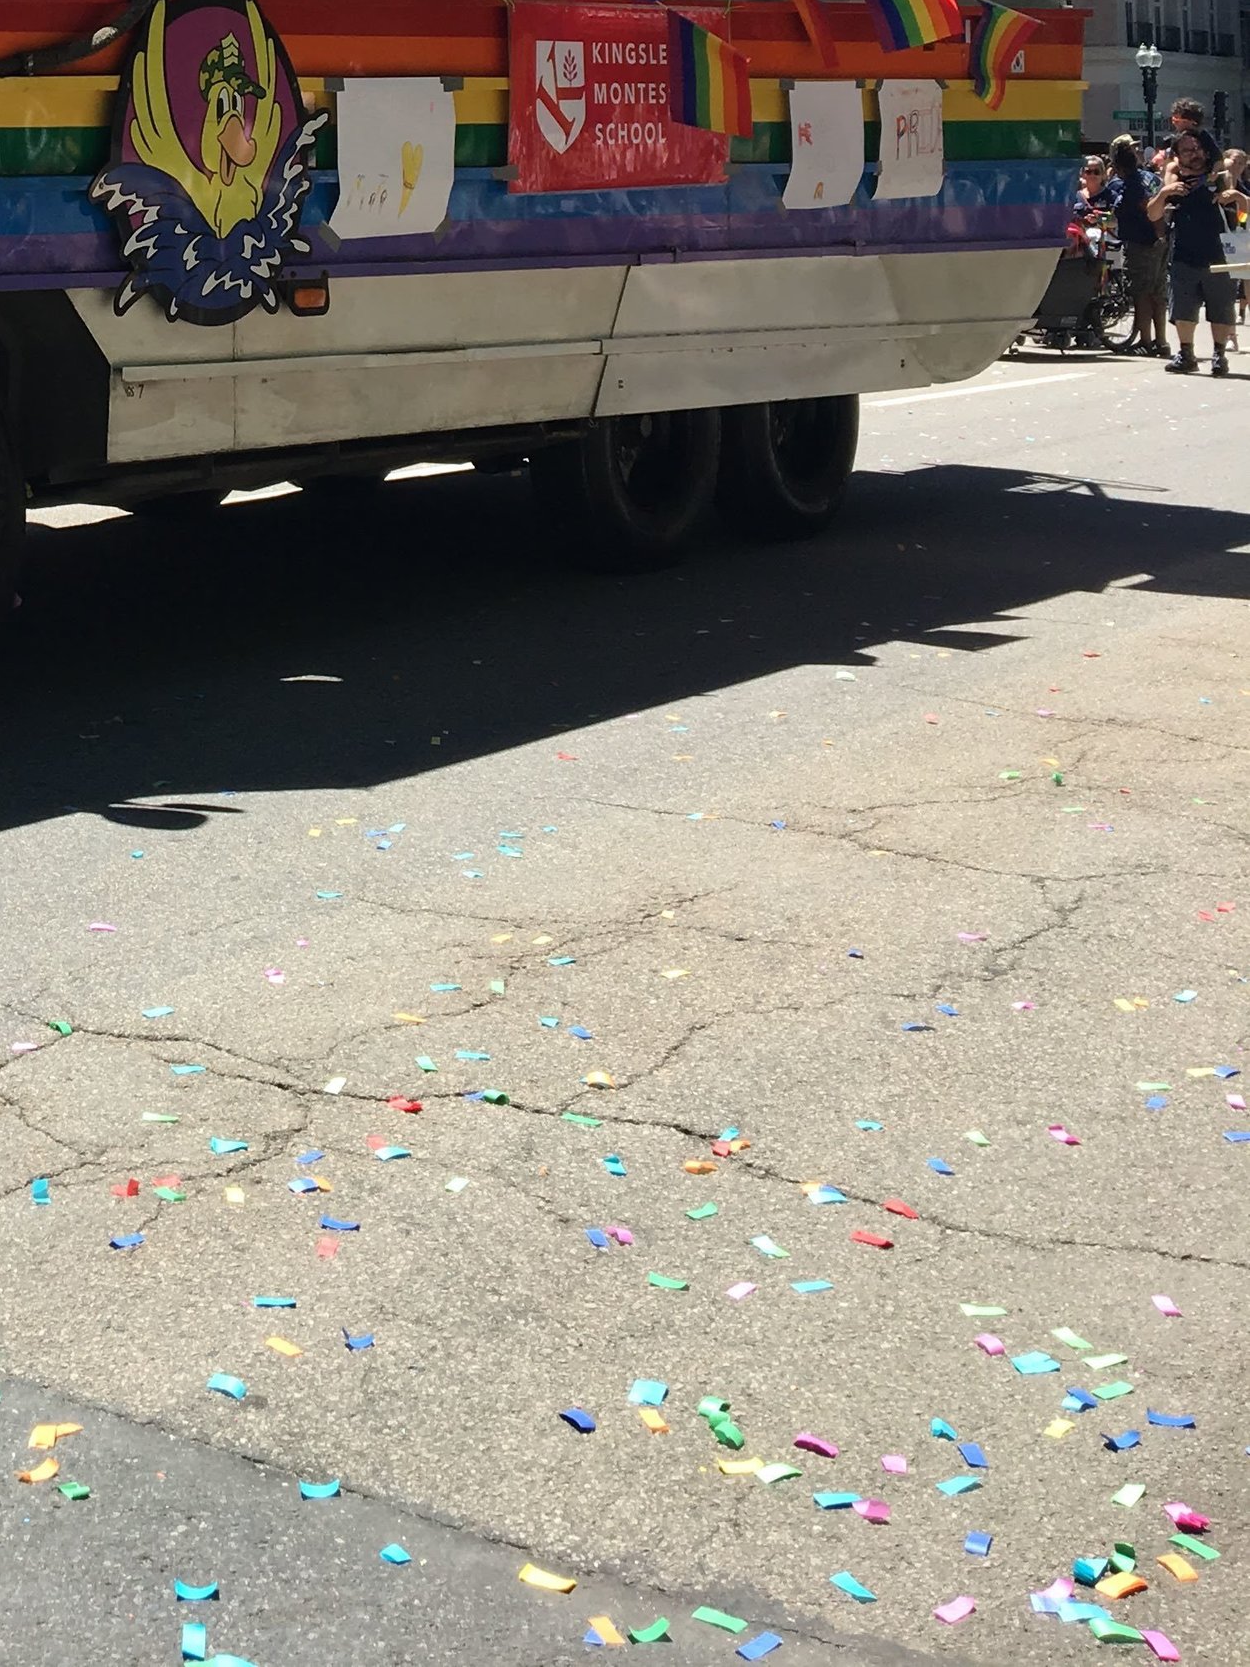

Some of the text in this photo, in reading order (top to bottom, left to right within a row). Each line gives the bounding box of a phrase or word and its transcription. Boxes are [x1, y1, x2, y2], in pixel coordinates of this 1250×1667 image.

[592, 42, 667, 65] KINGSLE
[594, 83, 667, 104] MONTES
[595, 123, 667, 145] SCHOOL
